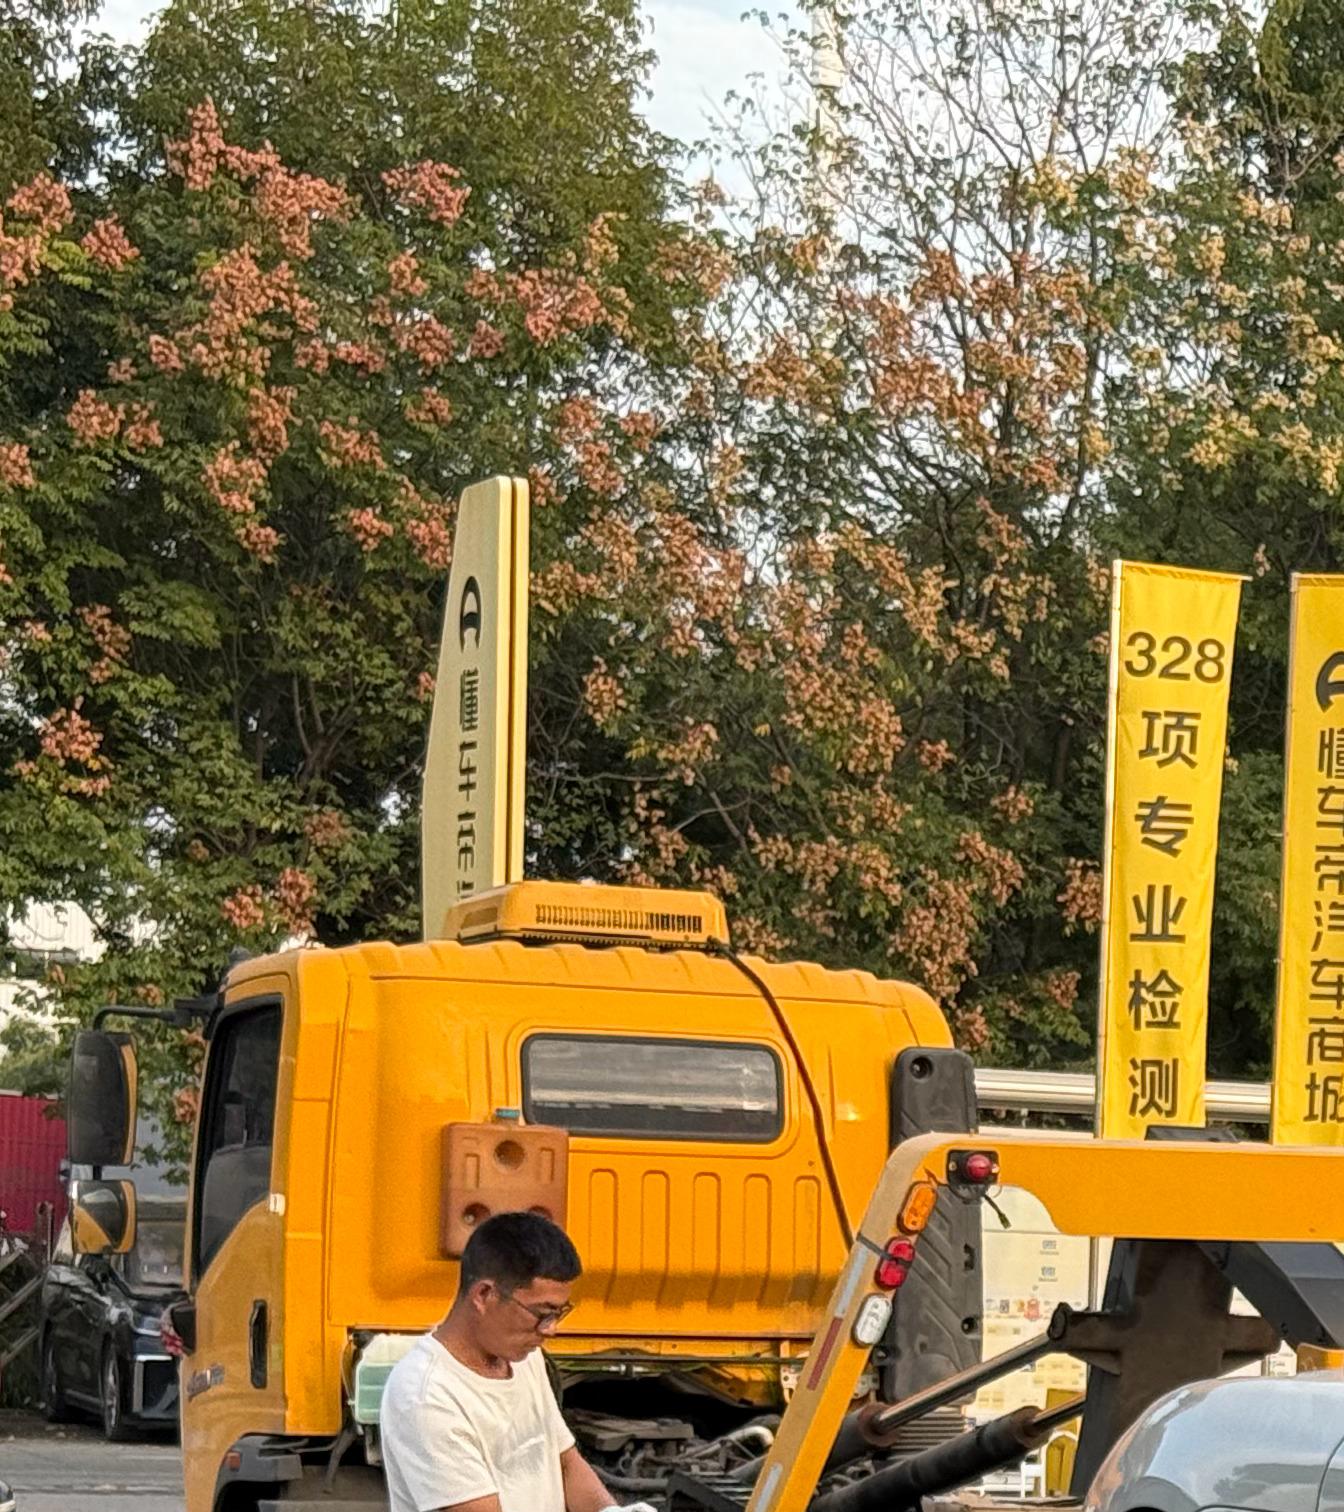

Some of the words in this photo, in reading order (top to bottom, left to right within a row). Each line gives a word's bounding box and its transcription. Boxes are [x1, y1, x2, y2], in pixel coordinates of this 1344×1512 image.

[457, 667, 479, 900] 懂车帝
[1124, 630, 1226, 1120] 328项专业检测
